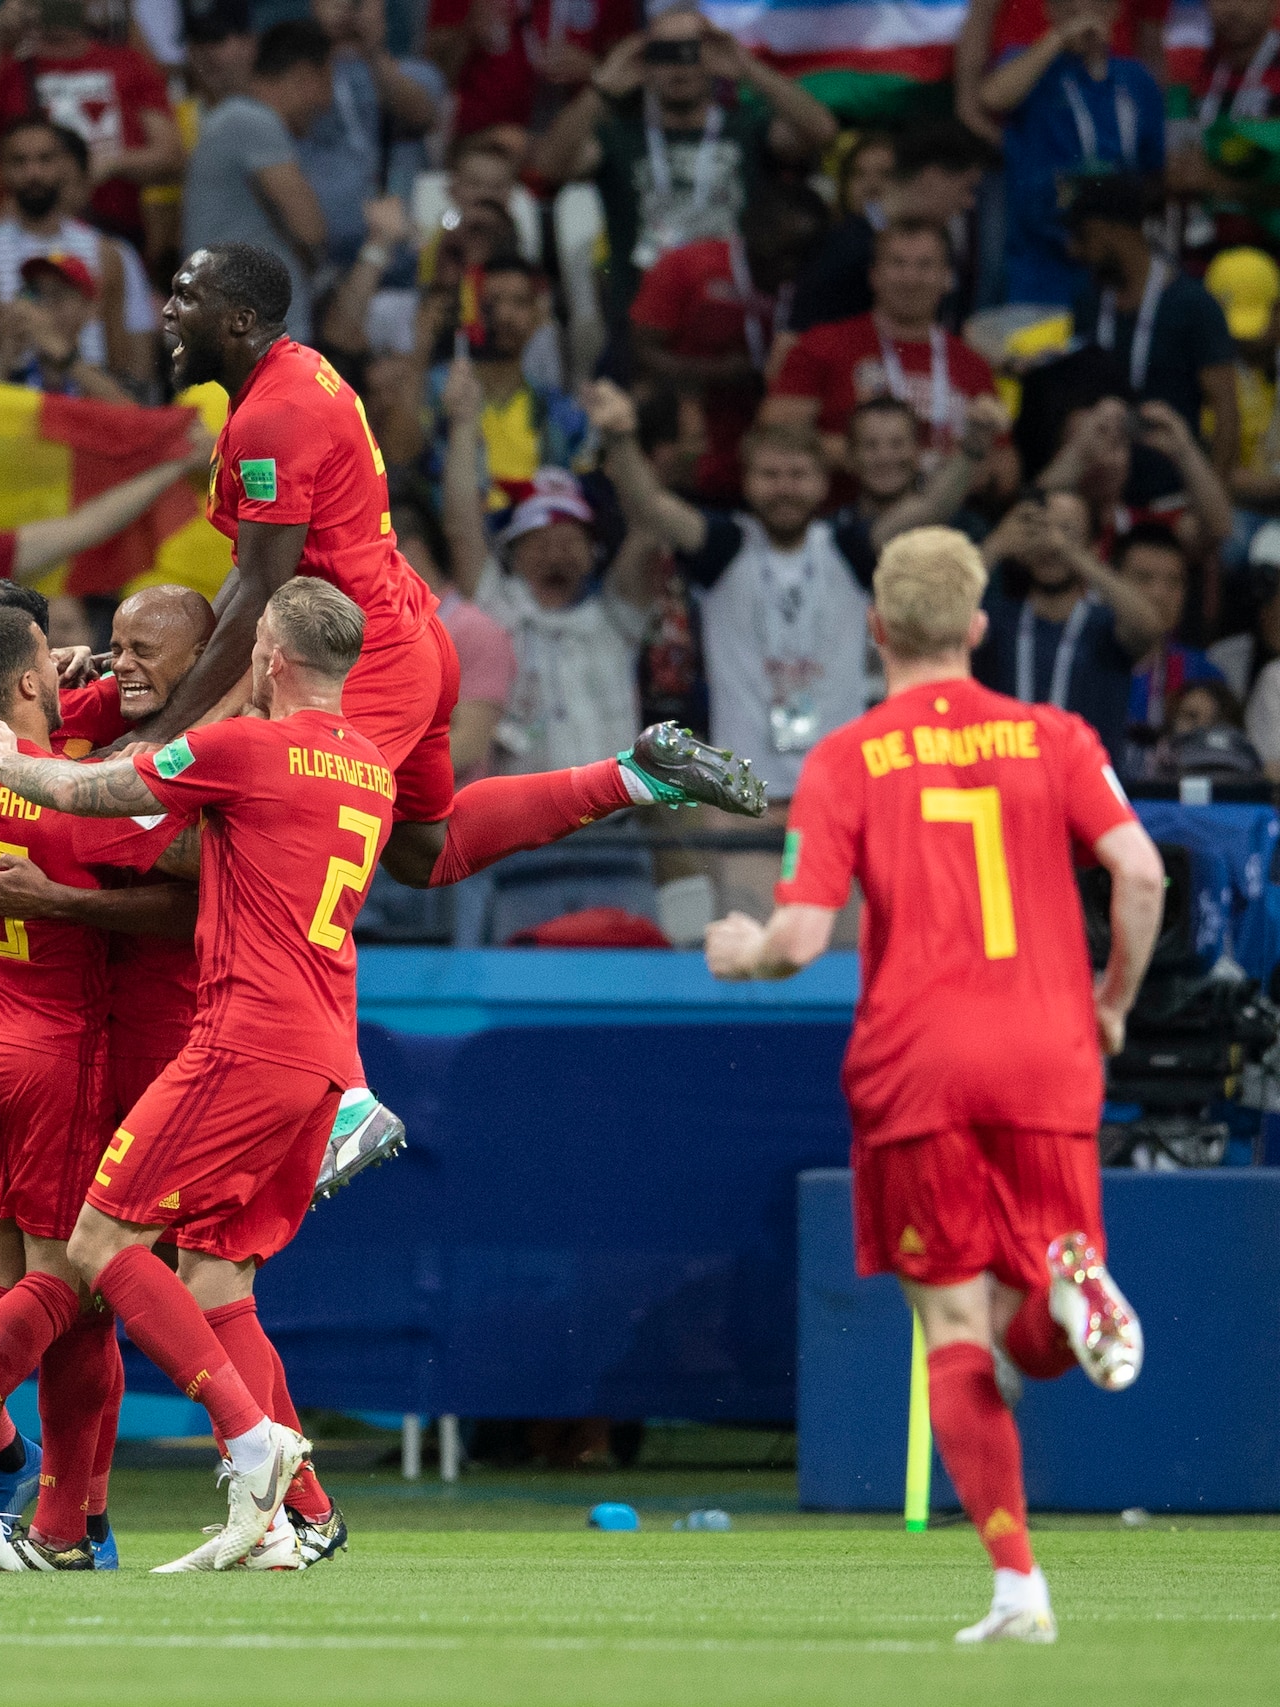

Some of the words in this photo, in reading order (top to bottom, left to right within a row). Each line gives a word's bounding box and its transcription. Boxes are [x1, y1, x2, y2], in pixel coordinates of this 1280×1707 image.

[288, 747, 394, 801] ALDERWEIREL
[861, 729, 914, 778] DE
[912, 720, 1040, 767] BRUYNE
[308, 805, 382, 951] 2
[921, 785, 1018, 960] 7
[95, 1127, 135, 1187] 2
